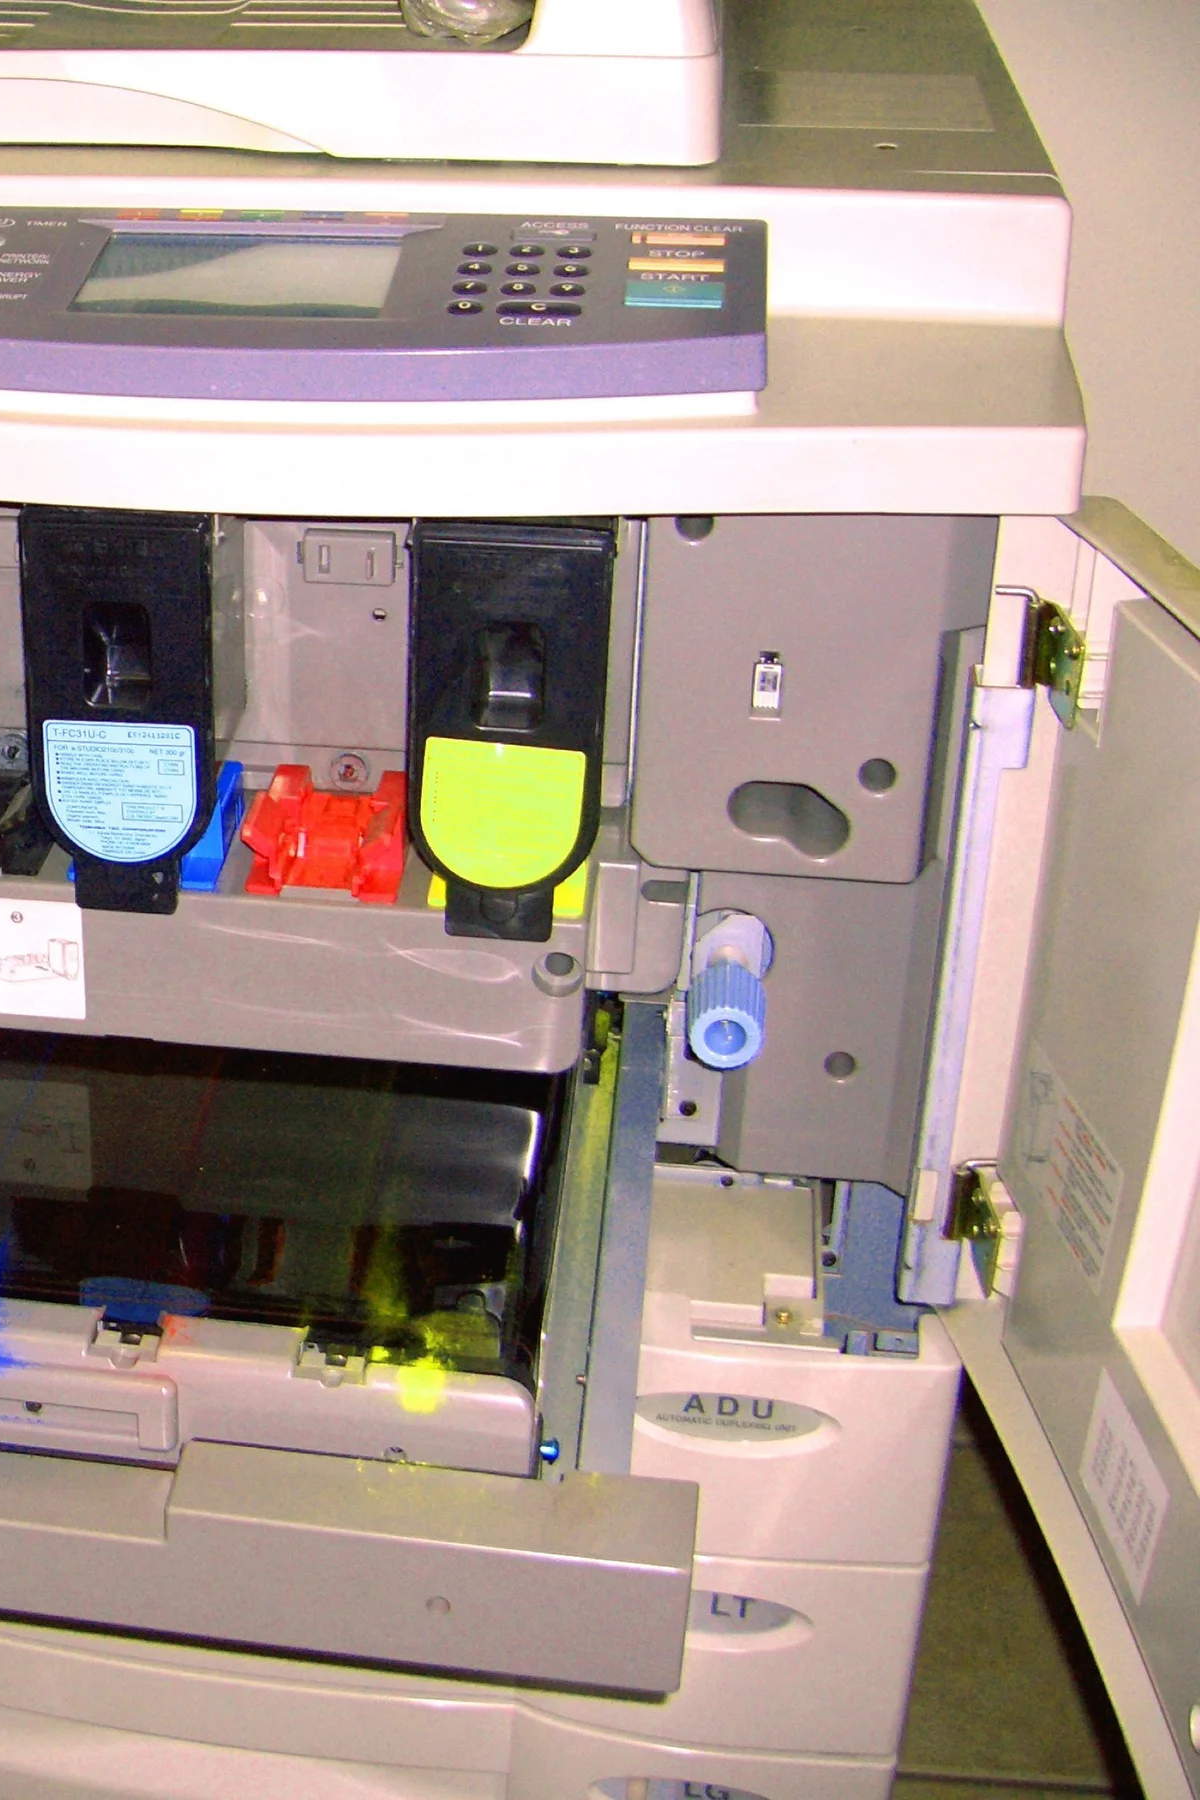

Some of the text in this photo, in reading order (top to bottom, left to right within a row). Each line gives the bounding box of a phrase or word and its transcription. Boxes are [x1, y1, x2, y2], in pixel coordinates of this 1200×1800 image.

[520, 222, 589, 230] ACCESS
[615, 223, 743, 233] FUNCTION CLEAR
[648, 249, 705, 258] STOP
[640, 272, 710, 281] START
[498, 317, 572, 327] CLEAR
[53, 728, 107, 739] T-FC31U-C
[655, 1413, 712, 1426] AUTOMATIC
[775, 1424, 797, 1432] UNIT
[710, 1591, 755, 1618] LT
[684, 1781, 730, 1800] LG
